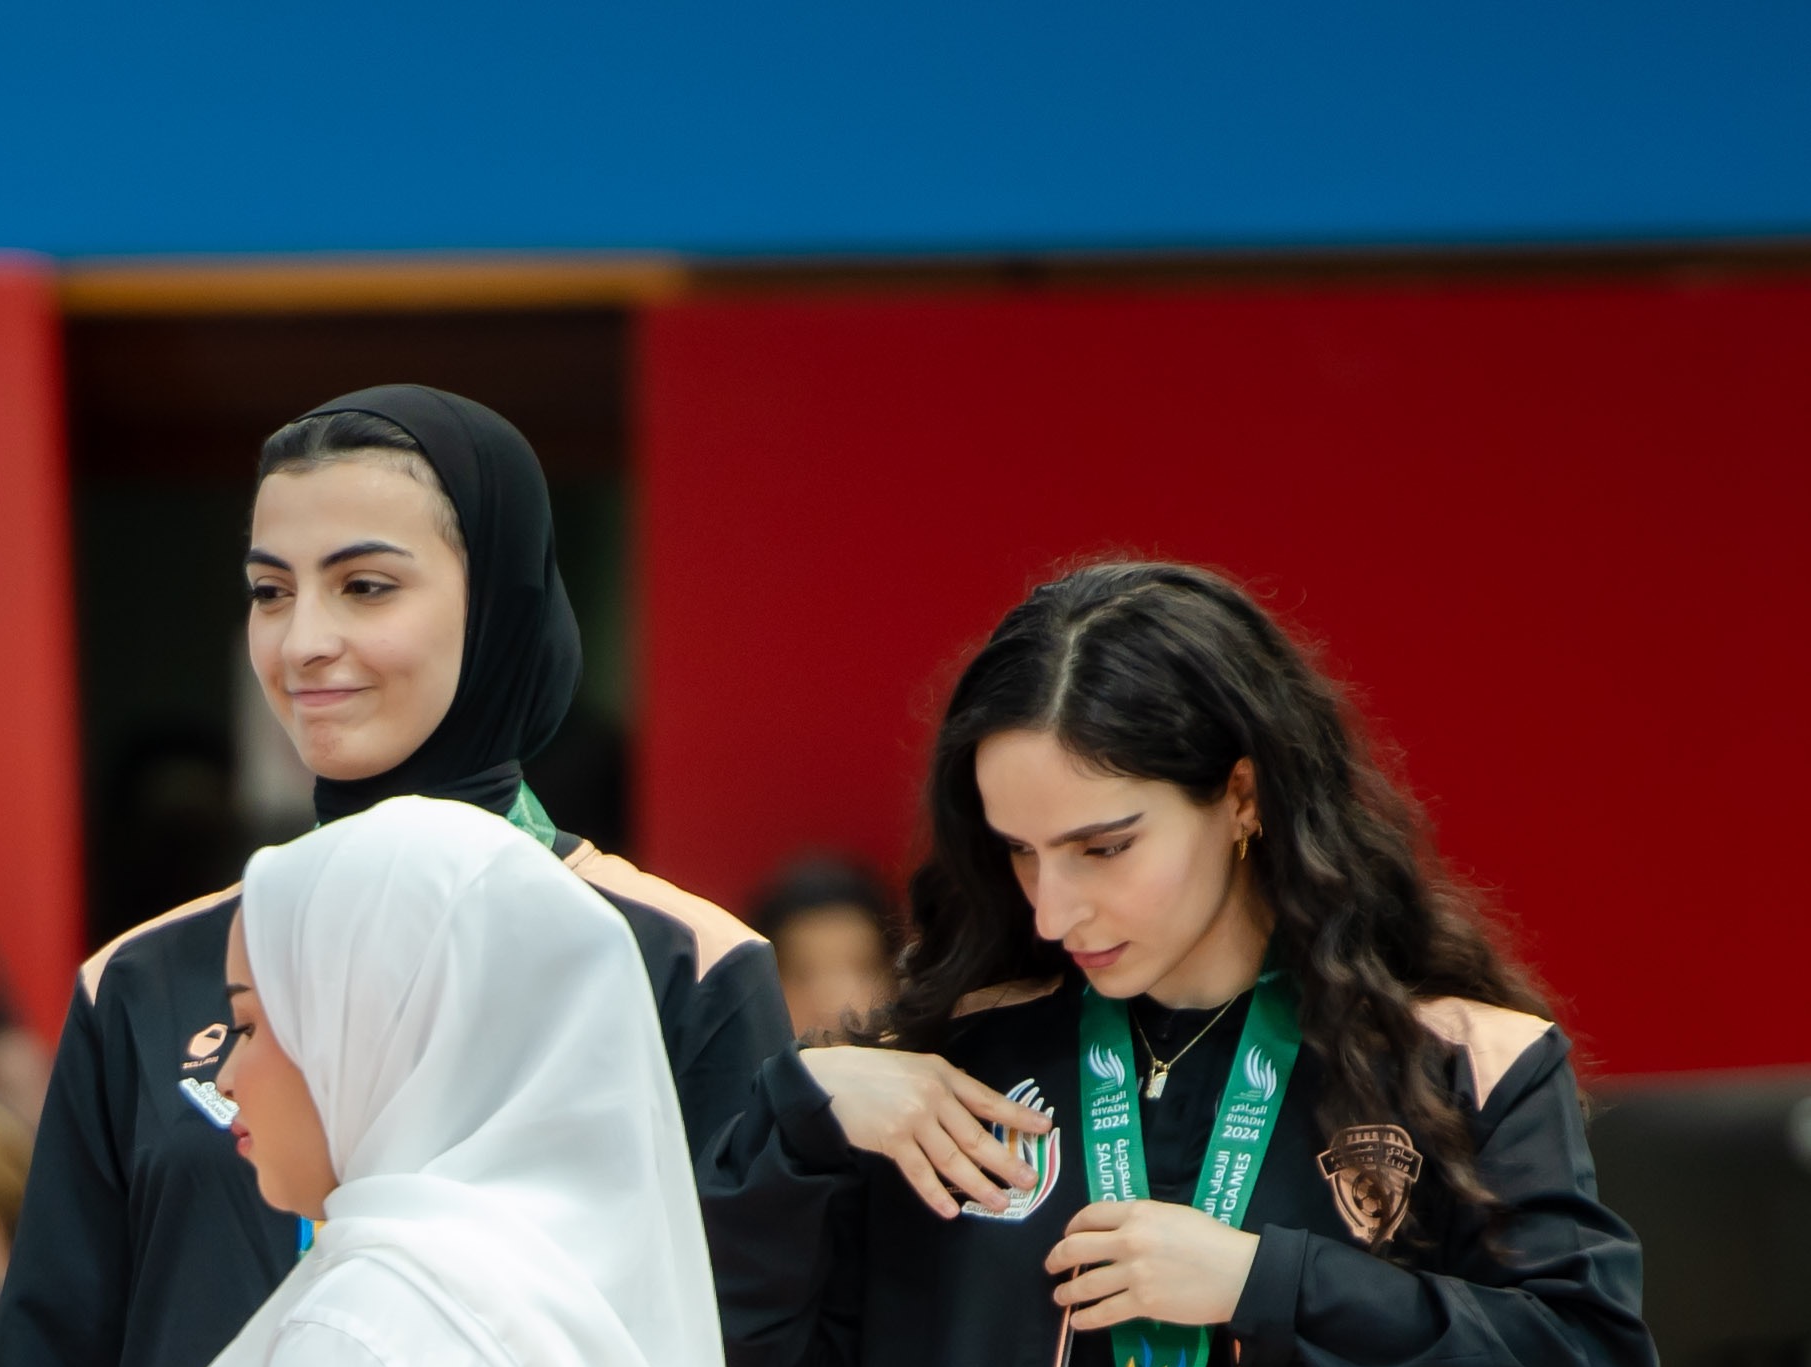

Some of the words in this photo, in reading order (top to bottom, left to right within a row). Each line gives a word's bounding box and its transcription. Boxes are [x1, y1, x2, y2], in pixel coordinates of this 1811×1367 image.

[1091, 1101, 1130, 1117] RIYADH
[1092, 1113, 1130, 1131] 2024
[1226, 1112, 1266, 1127] RIYADH
[1222, 1124, 1260, 1141] 2024
[1096, 1142, 1116, 1190] SAUDI
[1222, 1152, 1252, 1211] GAMES
